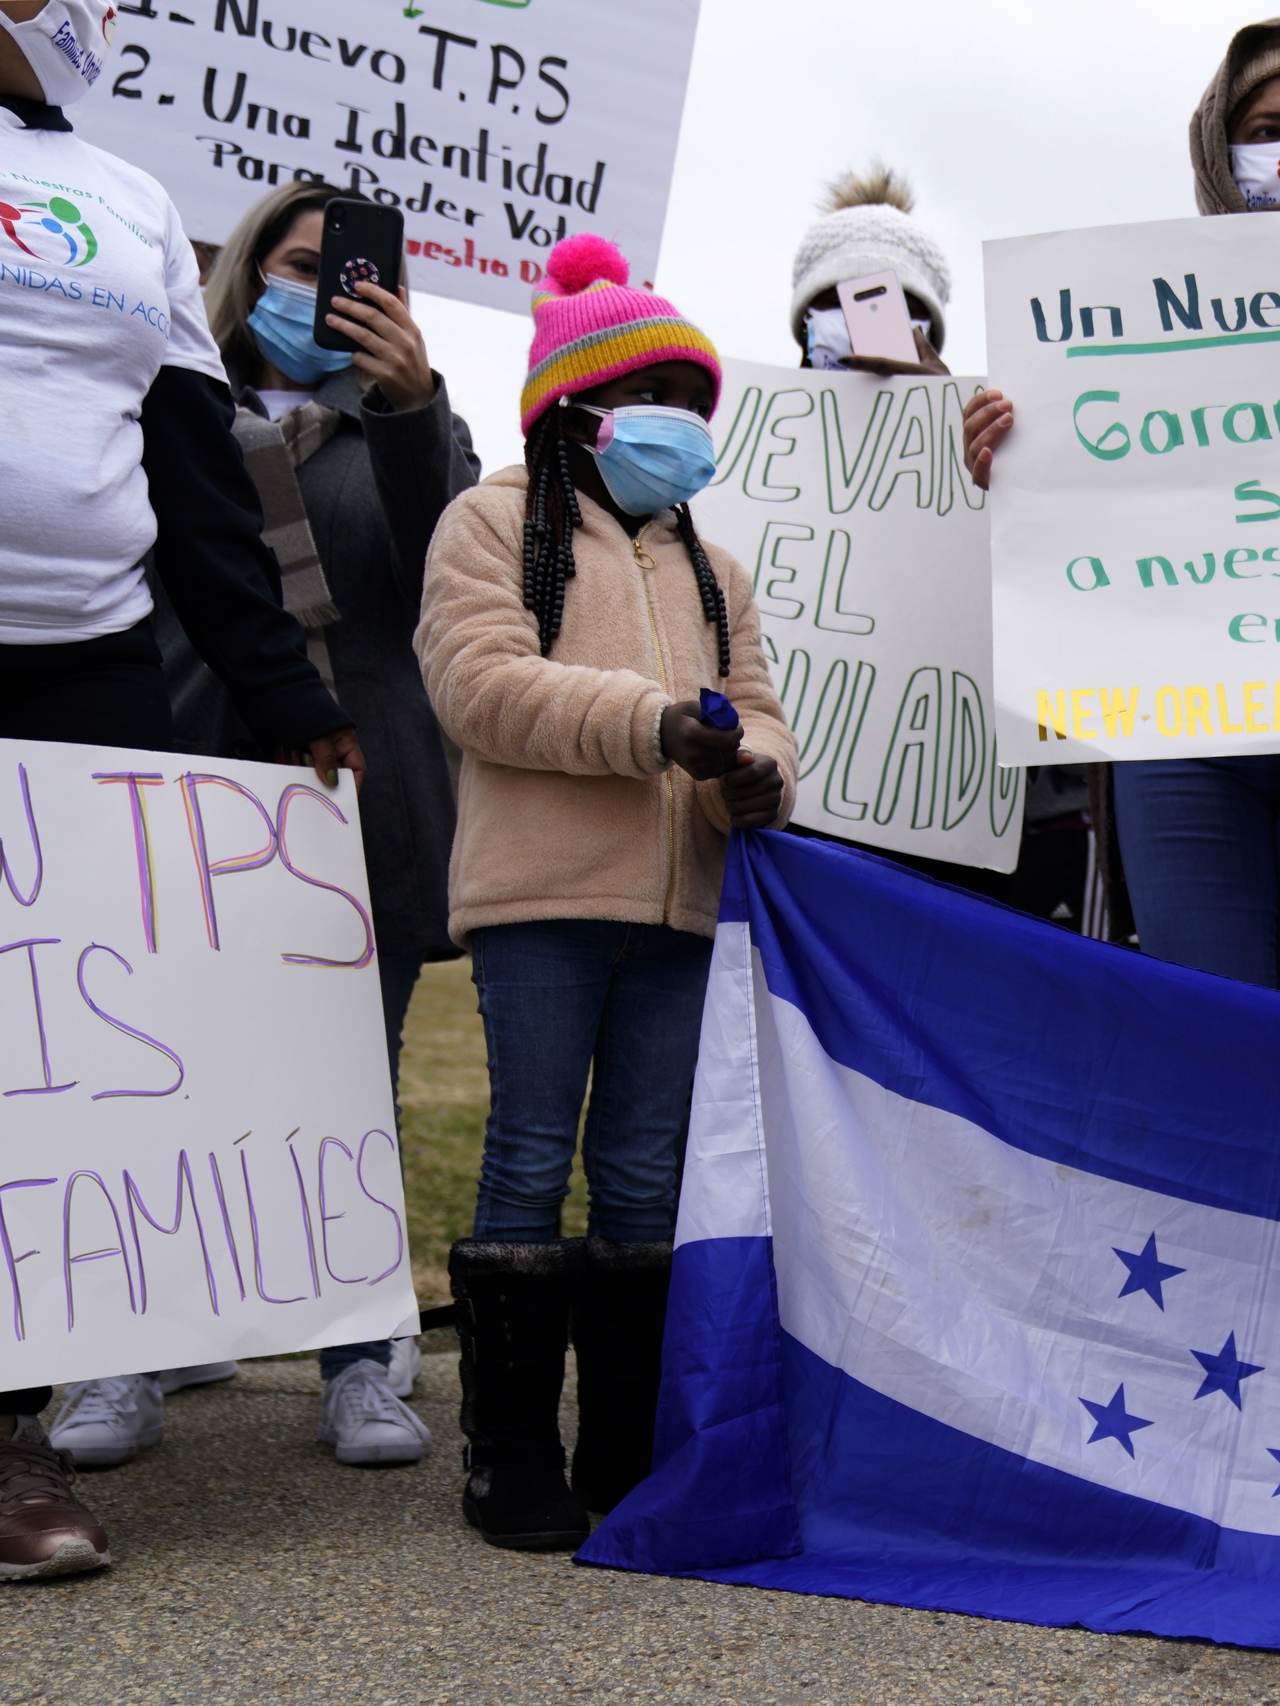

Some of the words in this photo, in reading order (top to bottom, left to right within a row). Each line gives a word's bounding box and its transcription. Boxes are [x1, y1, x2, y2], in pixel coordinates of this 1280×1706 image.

[213, 0, 407, 85] Nuevo
[203, 67, 311, 140] Una
[334, 101, 606, 214] Identidad
[10, 171, 94, 199] Nuestras
[97, 195, 154, 249] Familias
[343, 161, 486, 228] Poder
[92, 286, 125, 312] EN
[1030, 288, 1124, 343] Un
[754, 520, 875, 636] EL
[1066, 555, 1111, 592] a
[91, 770, 376, 969] TPS
